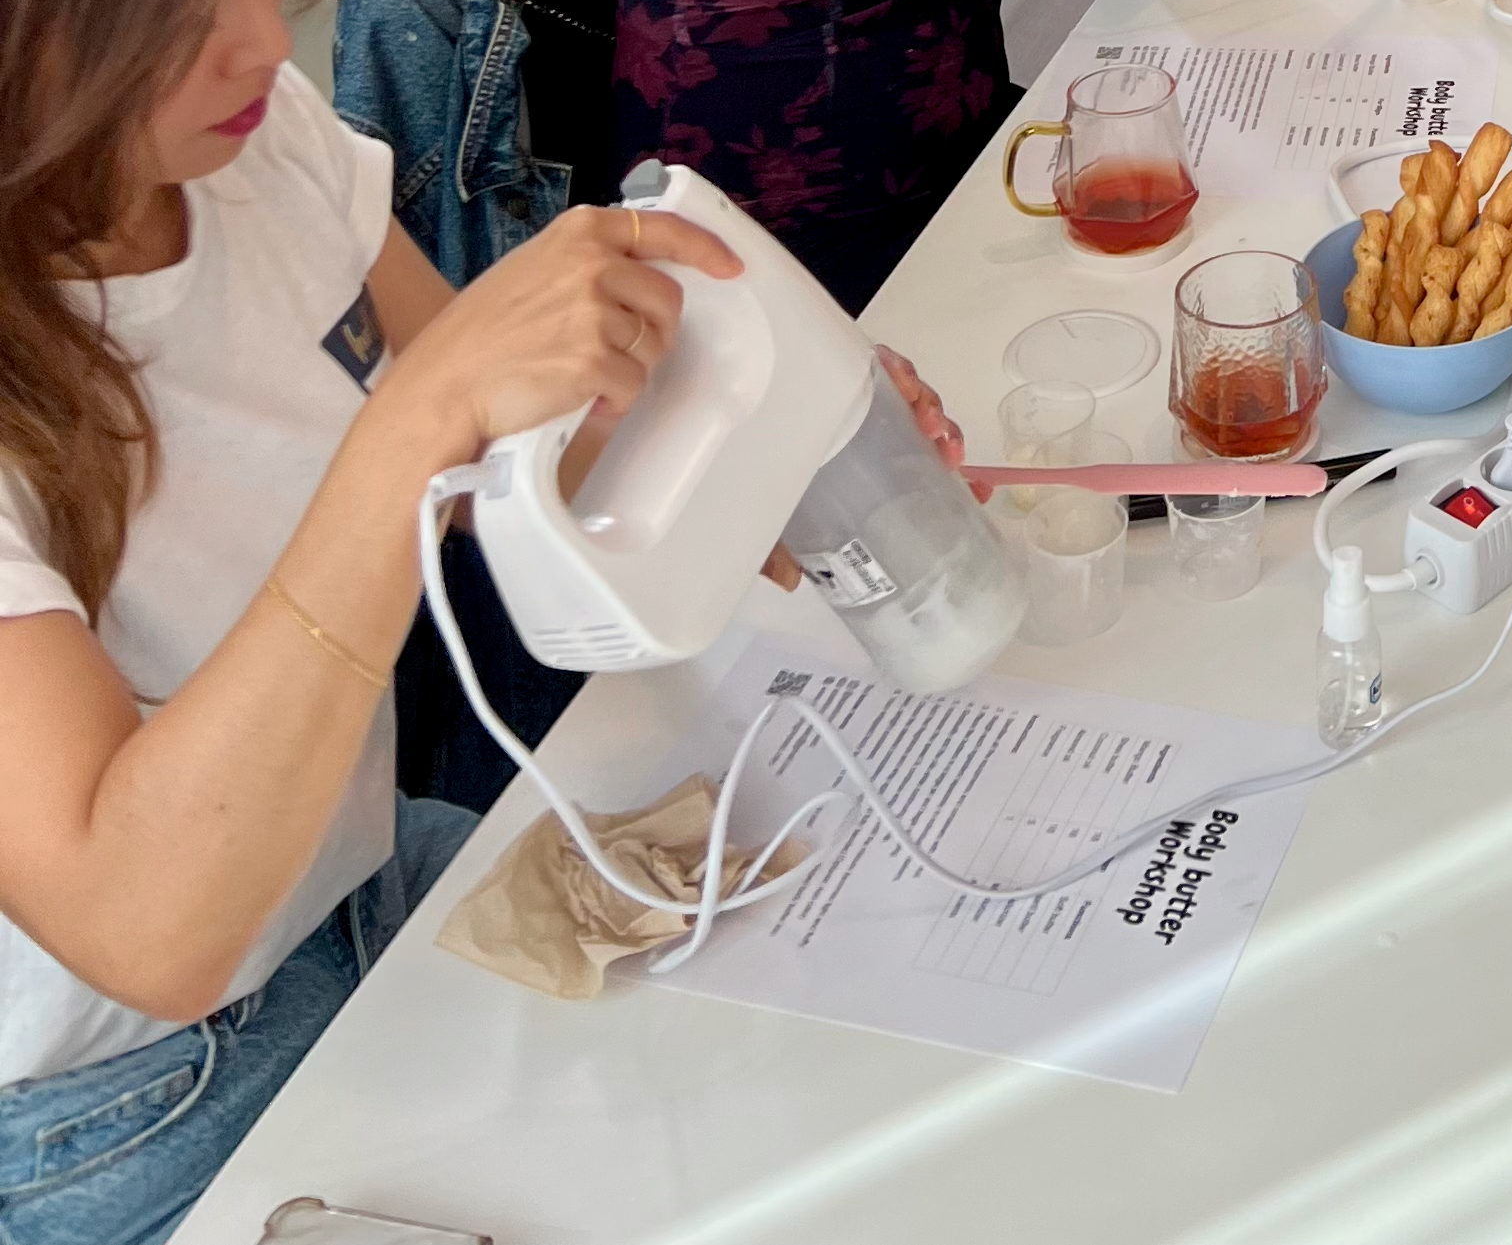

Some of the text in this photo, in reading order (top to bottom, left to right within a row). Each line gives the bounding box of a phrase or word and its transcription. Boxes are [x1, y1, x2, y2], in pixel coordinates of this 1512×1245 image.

[1395, 87, 1429, 136] Workshop
[1425, 80, 1455, 136] Body butte
[1115, 820, 1197, 925] Workshop
[1154, 809, 1240, 946] Body butter
